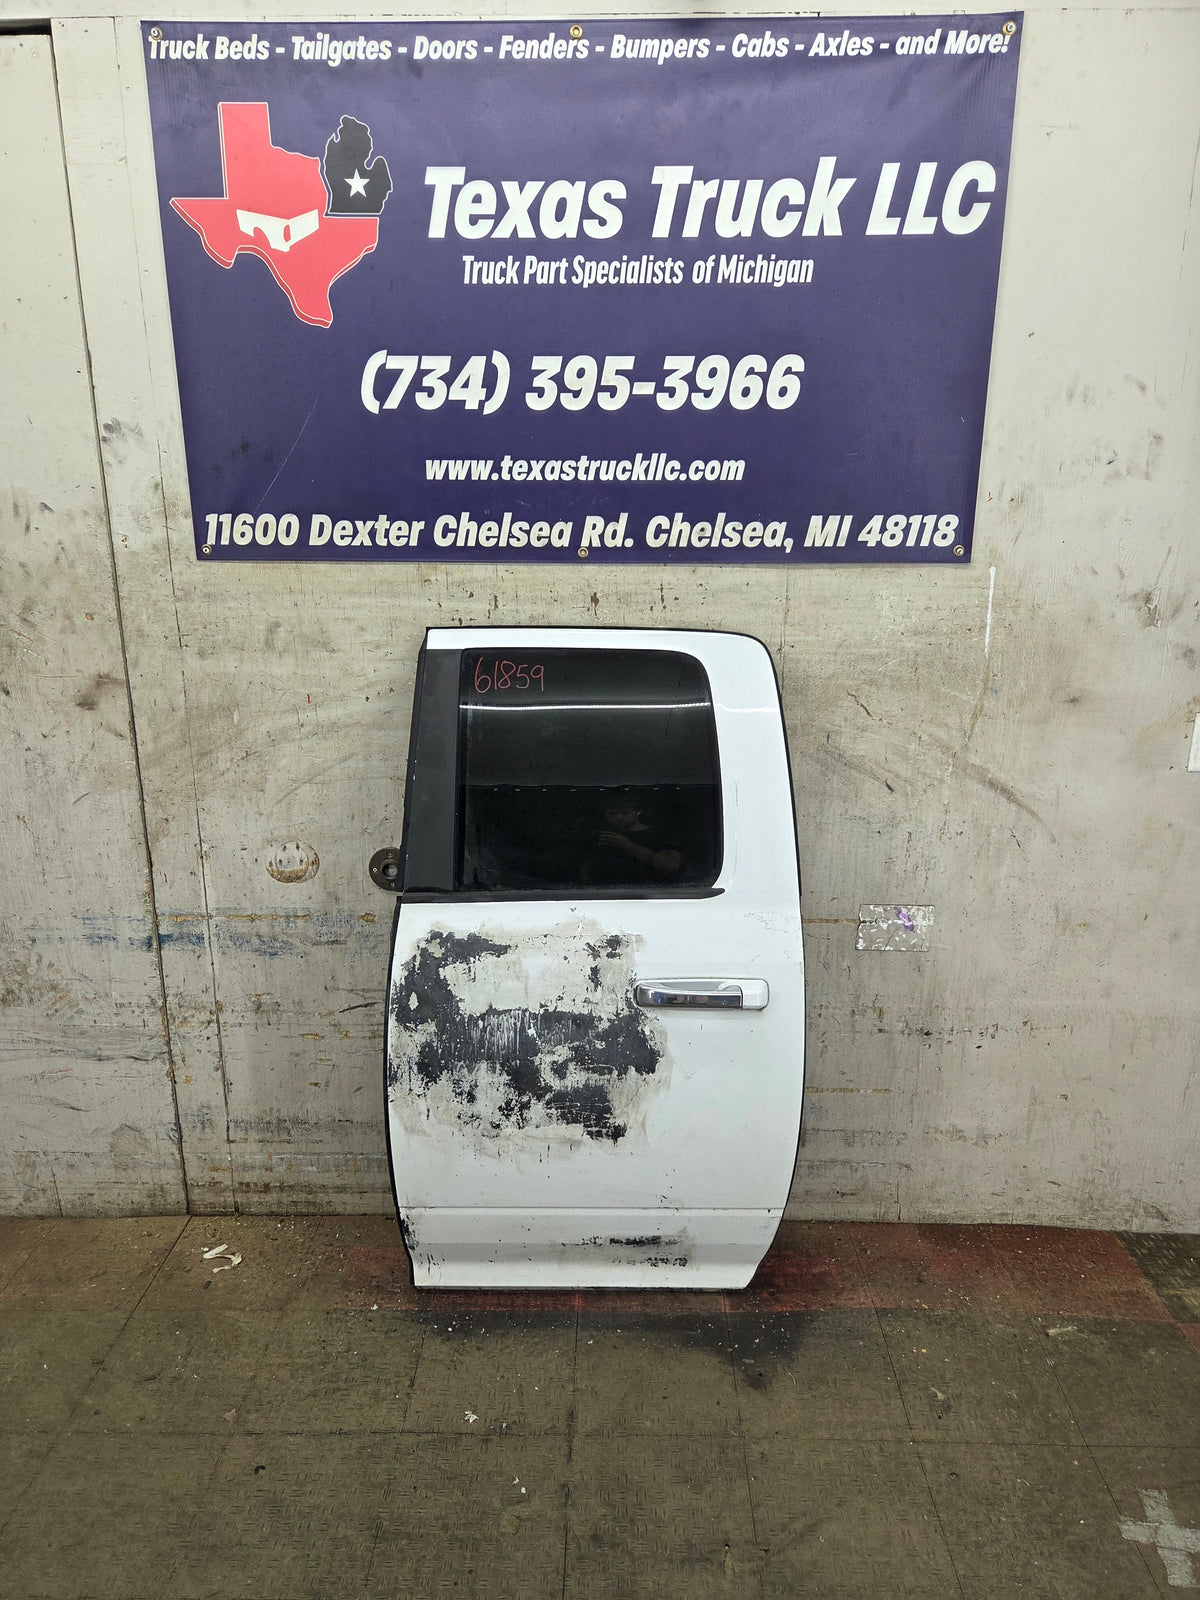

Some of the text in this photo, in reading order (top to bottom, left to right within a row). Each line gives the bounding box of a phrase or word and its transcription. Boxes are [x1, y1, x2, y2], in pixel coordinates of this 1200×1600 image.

[148, 33, 210, 60] Truck
[214, 35, 270, 60] Beds
[291, 33, 392, 67] Tailgates
[412, 35, 479, 60] Doors
[498, 33, 590, 60] Fenders
[609, 34, 711, 66] Bumpers
[731, 30, 790, 58] Cabs
[807, 29, 875, 57] Axles
[895, 29, 940, 56] and
[943, 29, 1011, 55] More!
[424, 155, 997, 240] Texas Truck LLC
[462, 253, 815, 289] Truck Part Specialists of Michigan
[360, 349, 805, 416] (734) 395-3966
[425, 452, 746, 481] www.texastruckllc.com
[205, 511, 959, 554] 11600 Dexter Chelsea Rd. Chelsea, MI 48118
[474, 656, 545, 694] 61859
